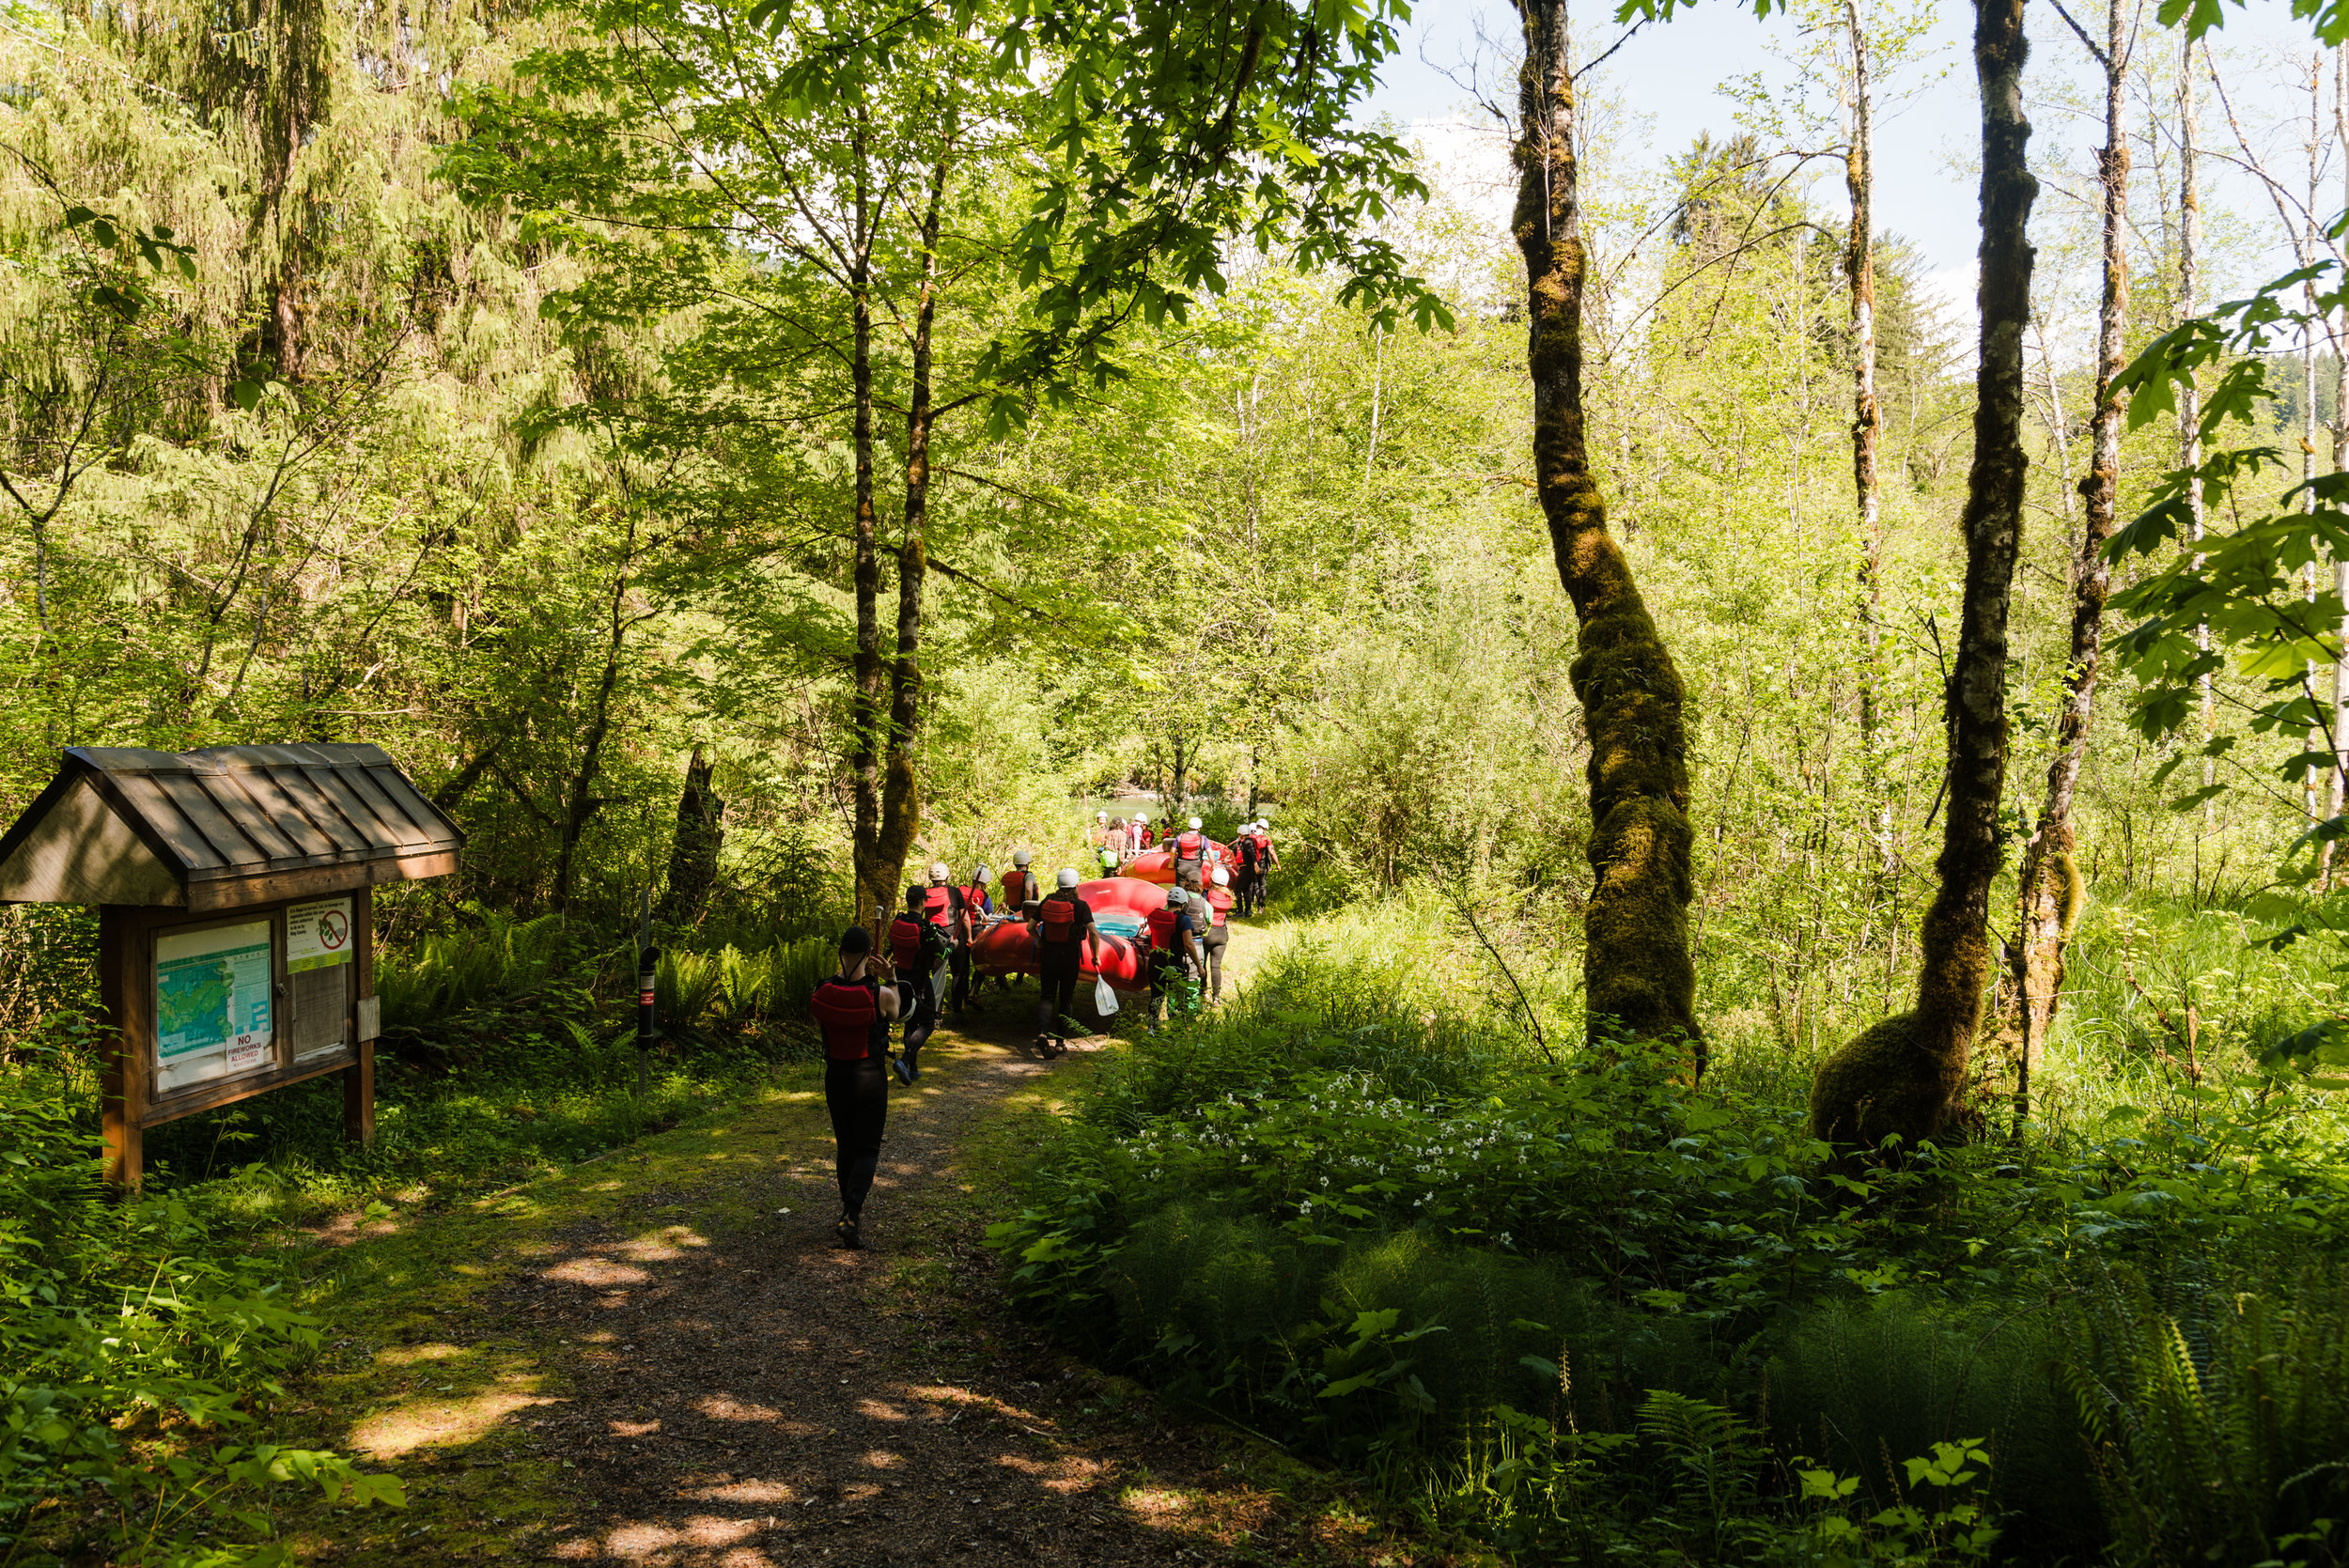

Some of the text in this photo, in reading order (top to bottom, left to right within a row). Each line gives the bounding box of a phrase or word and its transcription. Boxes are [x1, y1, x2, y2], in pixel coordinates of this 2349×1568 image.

[238, 1035, 251, 1045] NO
[228, 1043, 261, 1055] FIREWORKS
[231, 1050, 258, 1062] ALLOWED
